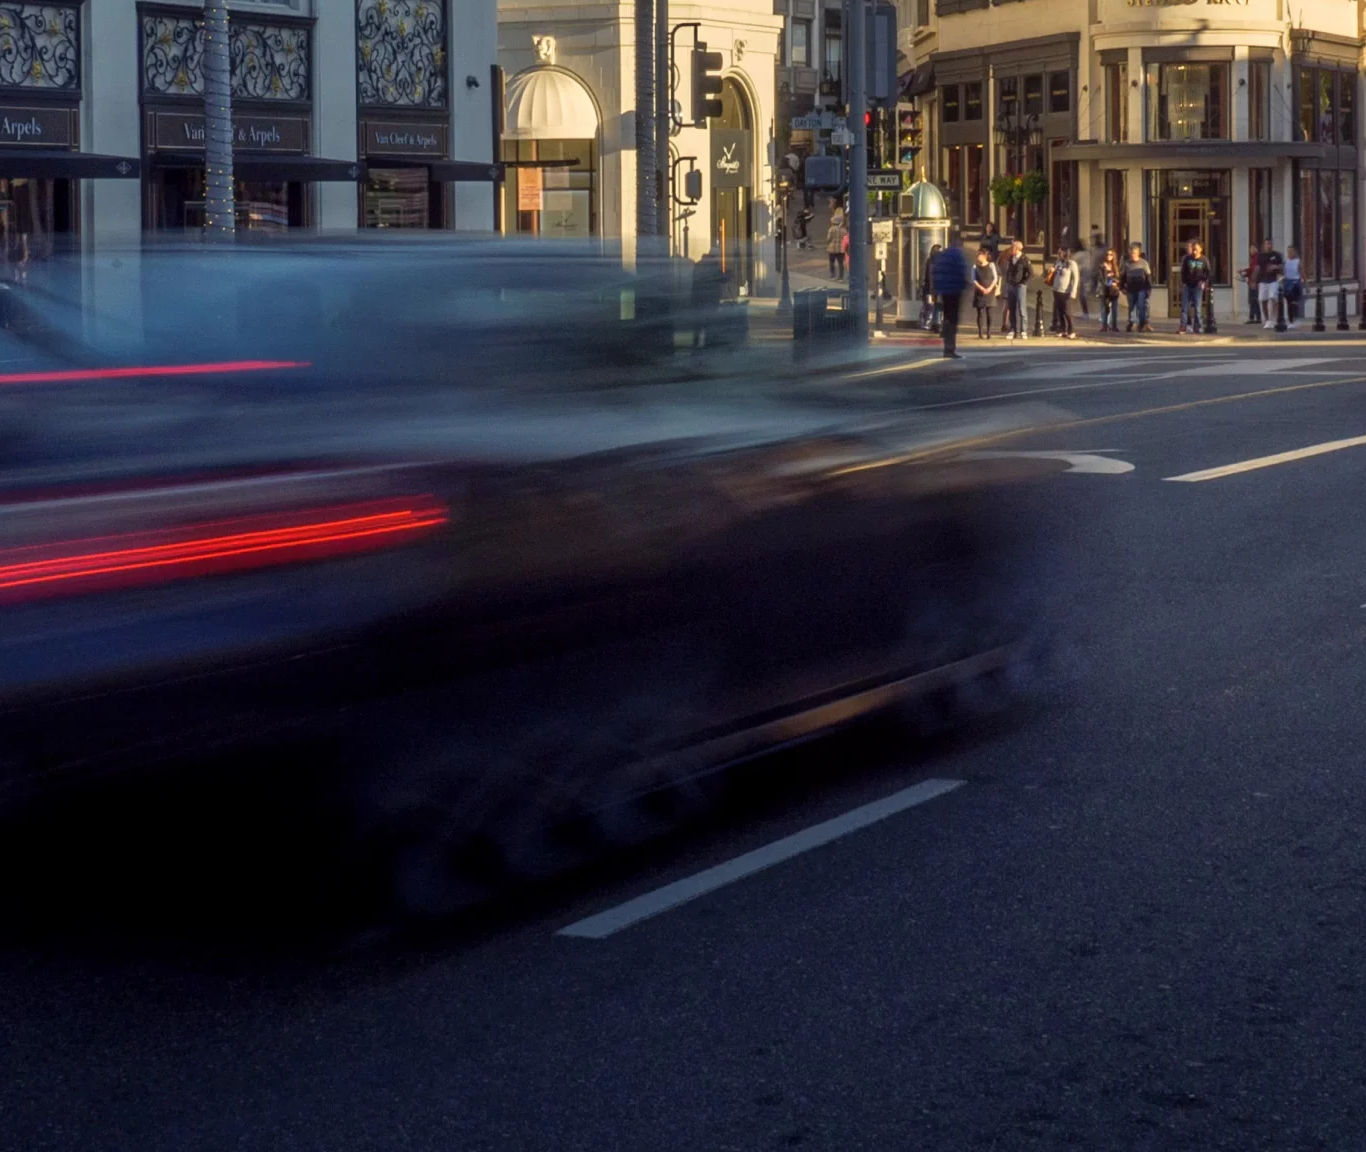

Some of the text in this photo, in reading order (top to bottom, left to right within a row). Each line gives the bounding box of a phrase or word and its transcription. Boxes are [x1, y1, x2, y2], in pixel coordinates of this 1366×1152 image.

[2, 116, 42, 141] Arpels
[794, 119, 822, 128] DAYTON
[183, 122, 281, 147] Van & Arpels
[375, 131, 389, 144] Van
[390, 131, 409, 145] Cleef
[416, 133, 437, 149] Arpels
[880, 176, 897, 184] WAY
